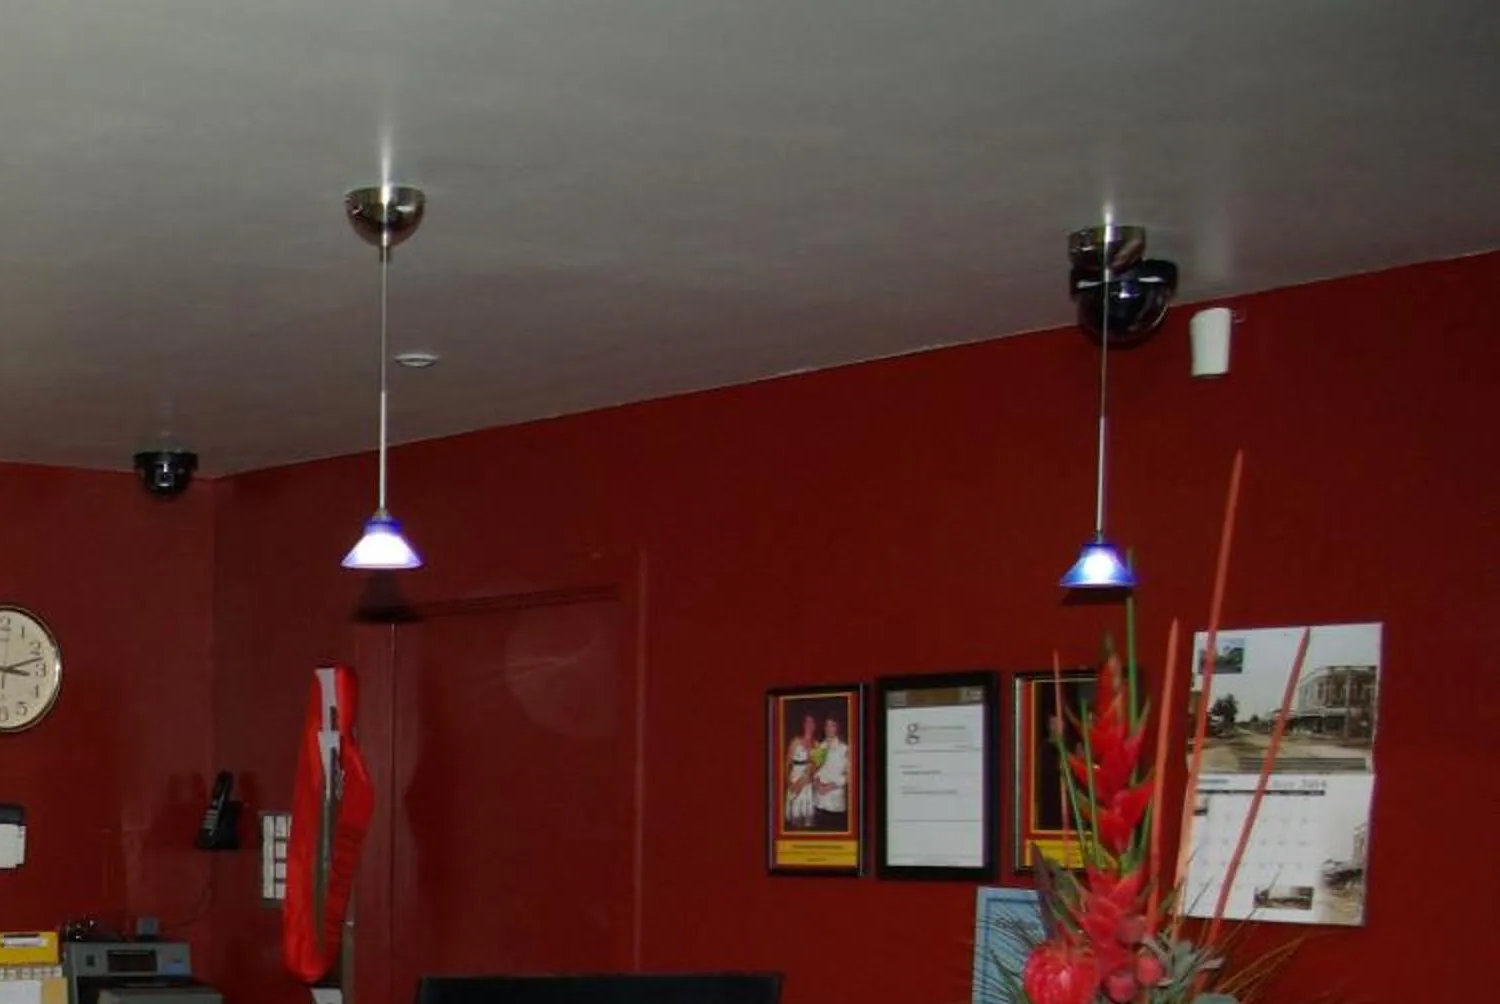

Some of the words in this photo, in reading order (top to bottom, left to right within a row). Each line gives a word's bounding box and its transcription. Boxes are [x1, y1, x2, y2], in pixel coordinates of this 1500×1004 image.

[29, 641, 41, 656] 2
[35, 663, 46, 676] 3
[16, 701, 28, 716] 5
